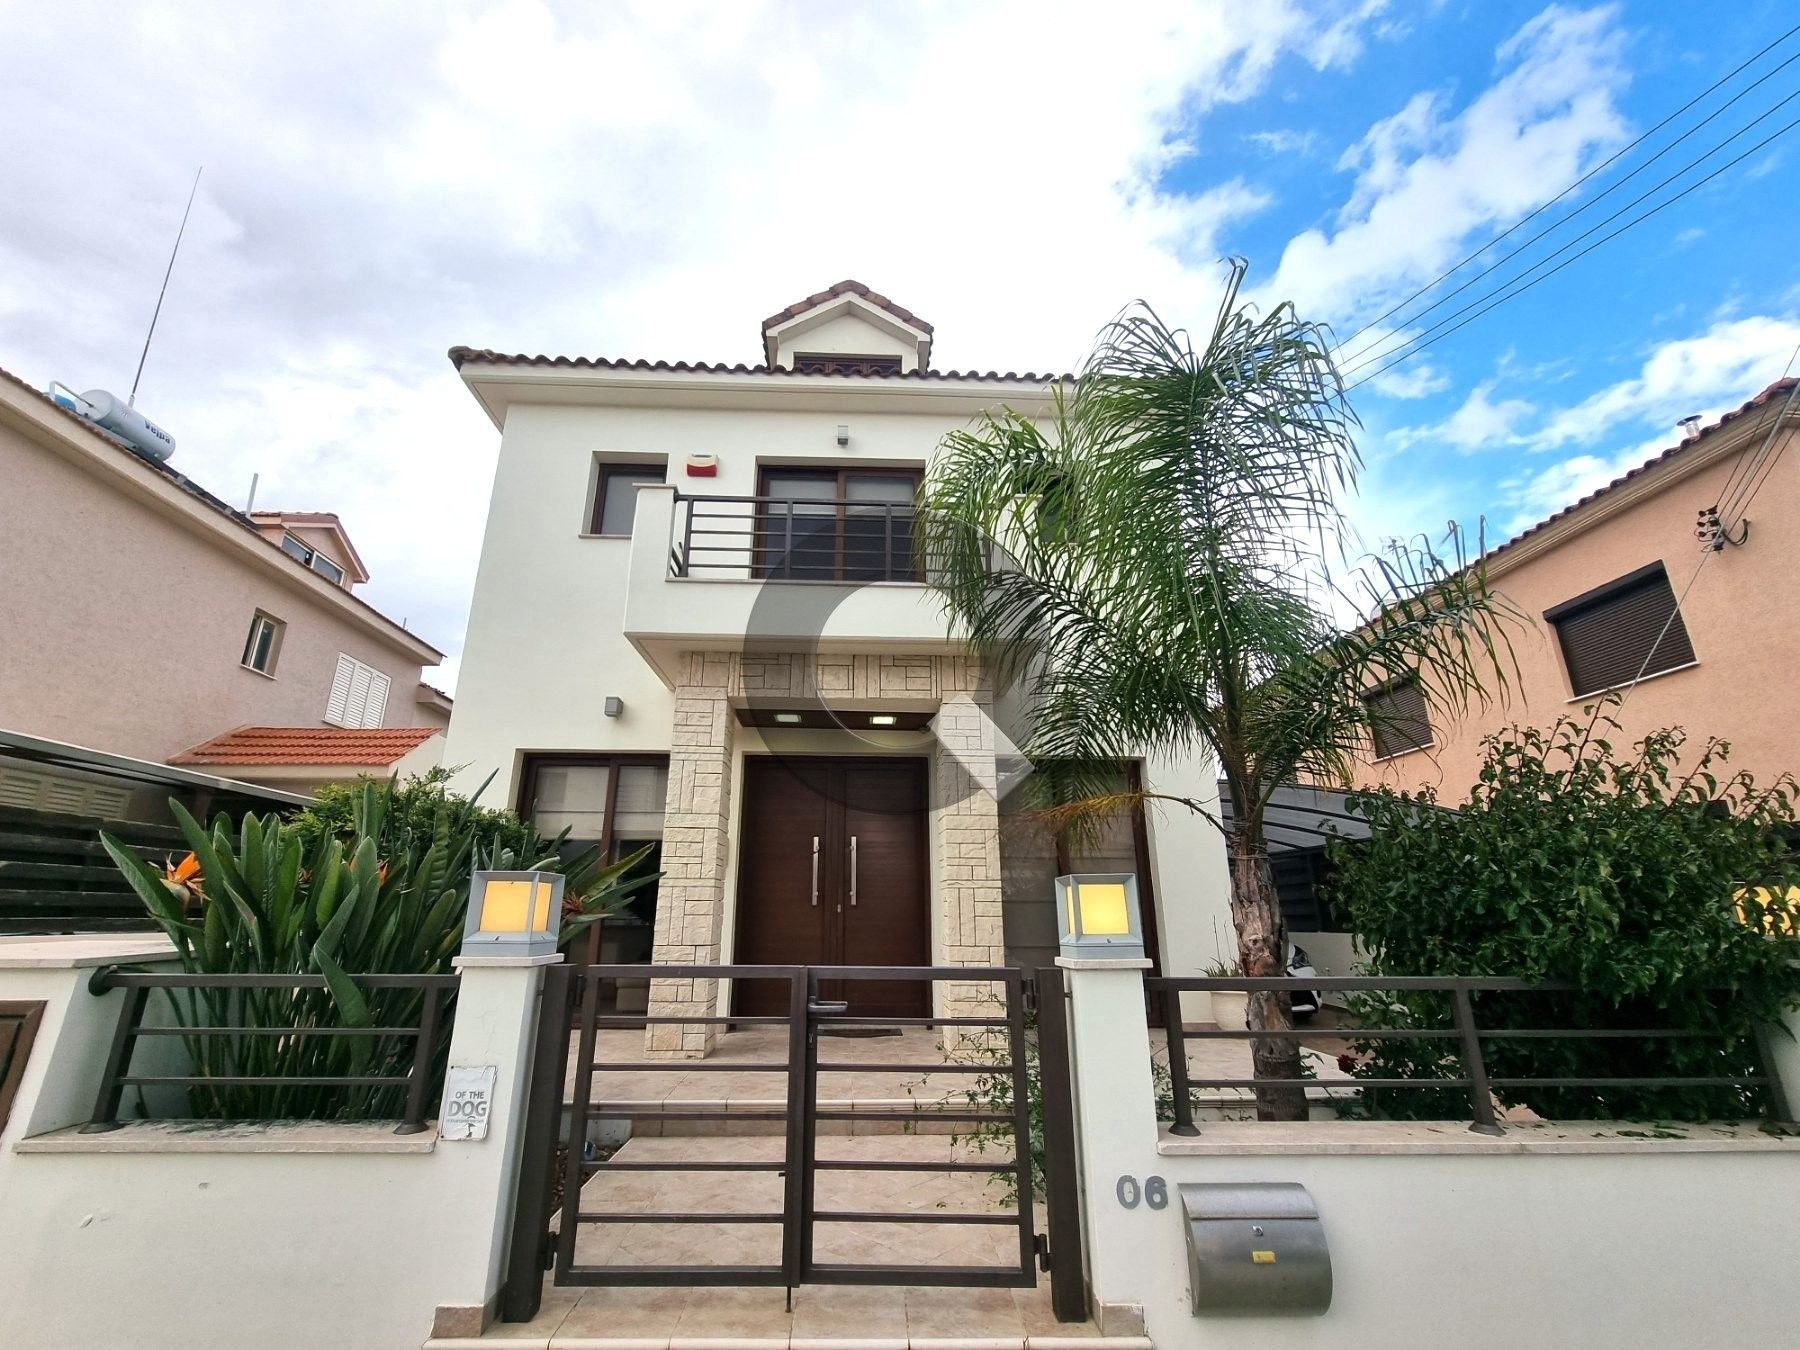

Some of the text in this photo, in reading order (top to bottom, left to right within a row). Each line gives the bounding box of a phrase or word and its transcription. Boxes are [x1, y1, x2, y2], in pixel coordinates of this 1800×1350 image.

[455, 1091, 485, 1100] OF THE
[448, 1101, 488, 1116] DOG
[1116, 1174, 1169, 1211] 06
